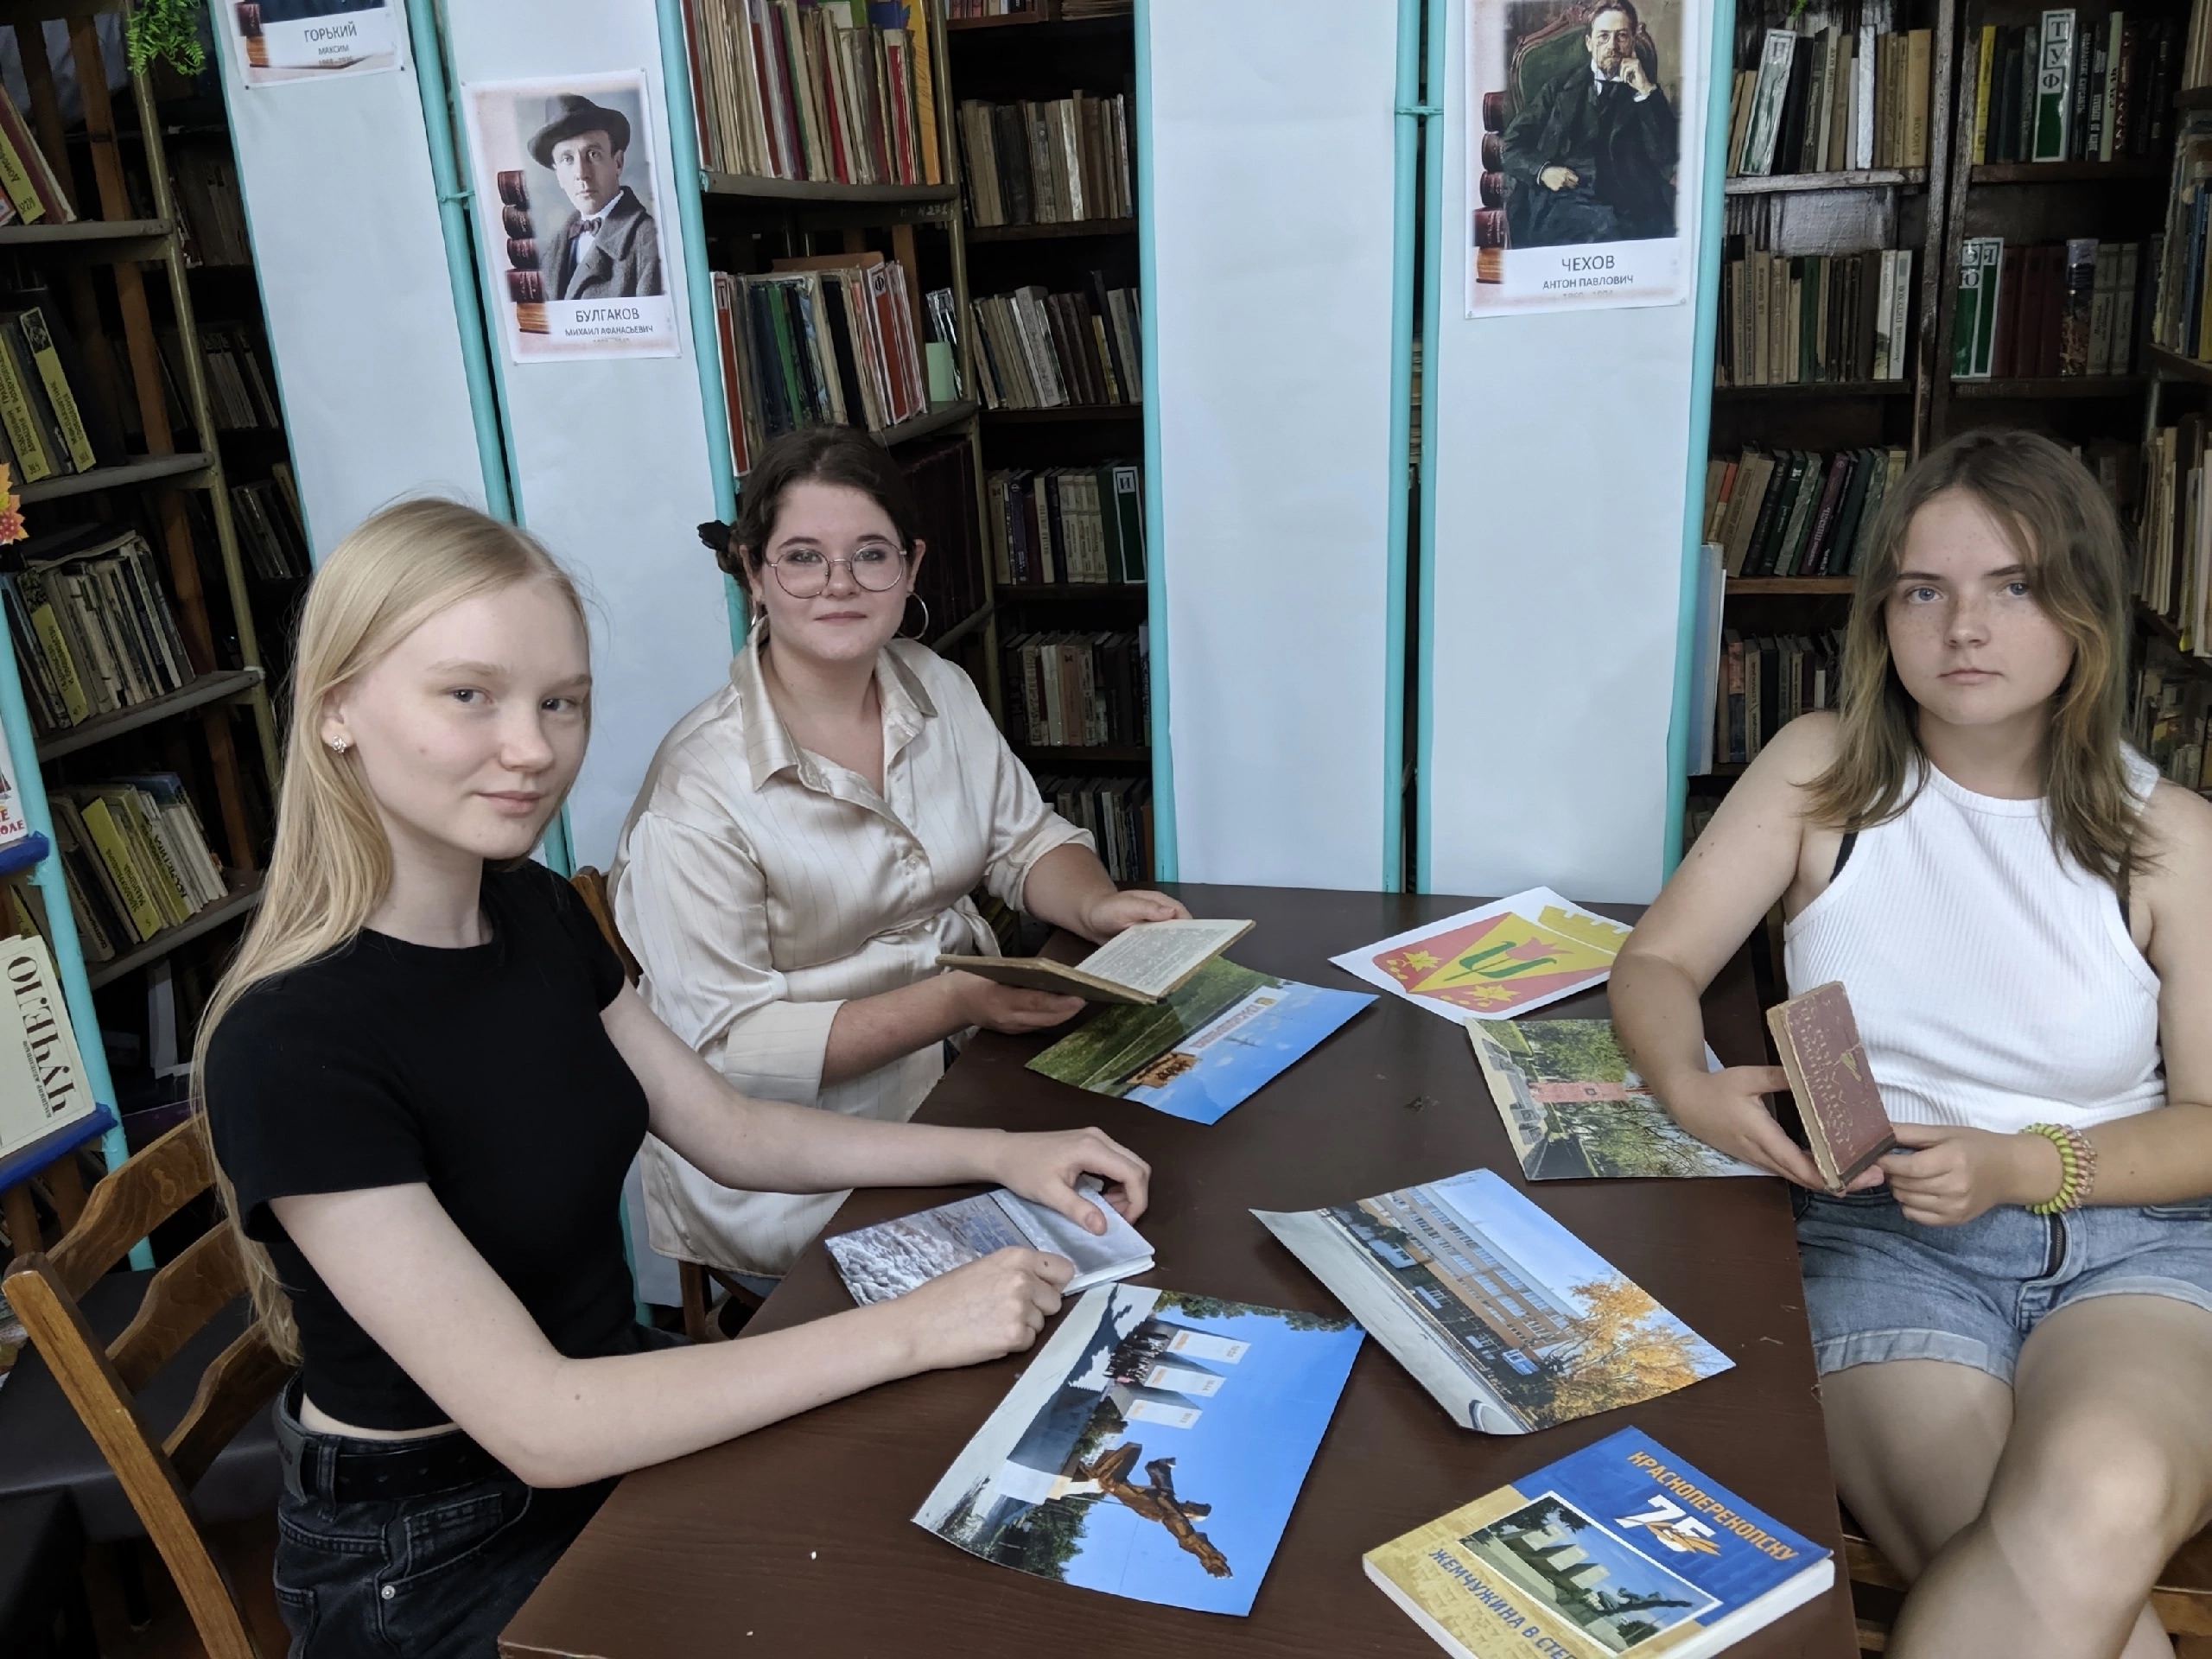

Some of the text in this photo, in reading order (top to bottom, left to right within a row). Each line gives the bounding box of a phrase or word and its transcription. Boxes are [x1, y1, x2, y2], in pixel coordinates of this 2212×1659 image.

[304, 21, 357, 42] ГОРЬКИЙ
[2051, 21, 2065, 37] Т
[318, 44, 349, 55] МАКСИМ
[2050, 48, 2064, 64] У
[2043, 73, 2060, 89] Ф
[1562, 255, 1615, 272] ЧЕХОВ
[1984, 249, 1994, 263] Я
[874, 276, 885, 291] Ф
[1543, 275, 1633, 289] АНТОН ПАВЛОВИЧ
[575, 308, 639, 322] БУЛГАКОВ
[565, 325, 653, 336] МИХАИЛ АФАНАСЬЕВИЧ
[1892, 285, 1904, 362] Анатолий ПЕТУХОВ
[1120, 477, 1131, 489] И
[7, 957, 75, 1114] ЧУЧЕЛО
[1627, 1451, 1798, 1560] КРАСНОПЕРЕКОПСКУ
[1614, 1494, 1716, 1553] 75
[1428, 1548, 1578, 1659] ЖЕМЧУЖИНА В СТЕ
